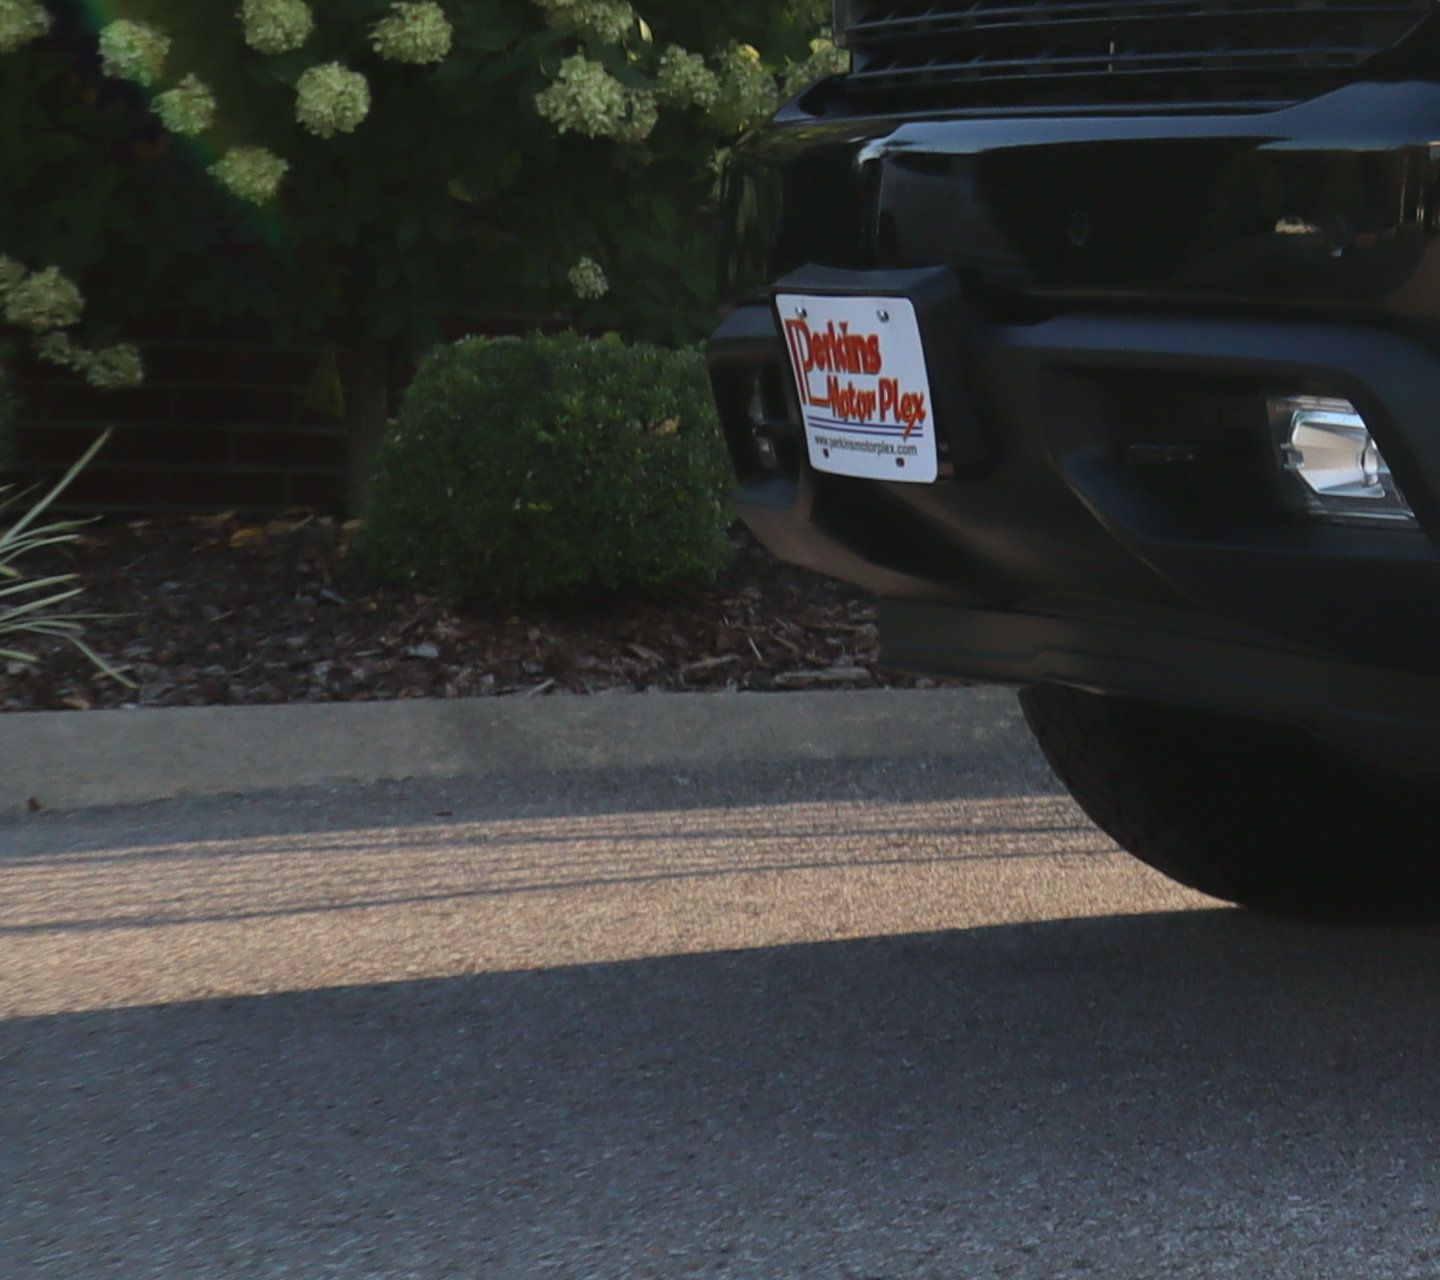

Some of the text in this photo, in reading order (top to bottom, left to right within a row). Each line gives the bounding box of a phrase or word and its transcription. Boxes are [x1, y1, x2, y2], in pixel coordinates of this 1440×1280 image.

[784, 317, 882, 406] Perkins
[827, 375, 926, 440] Motor Plex
